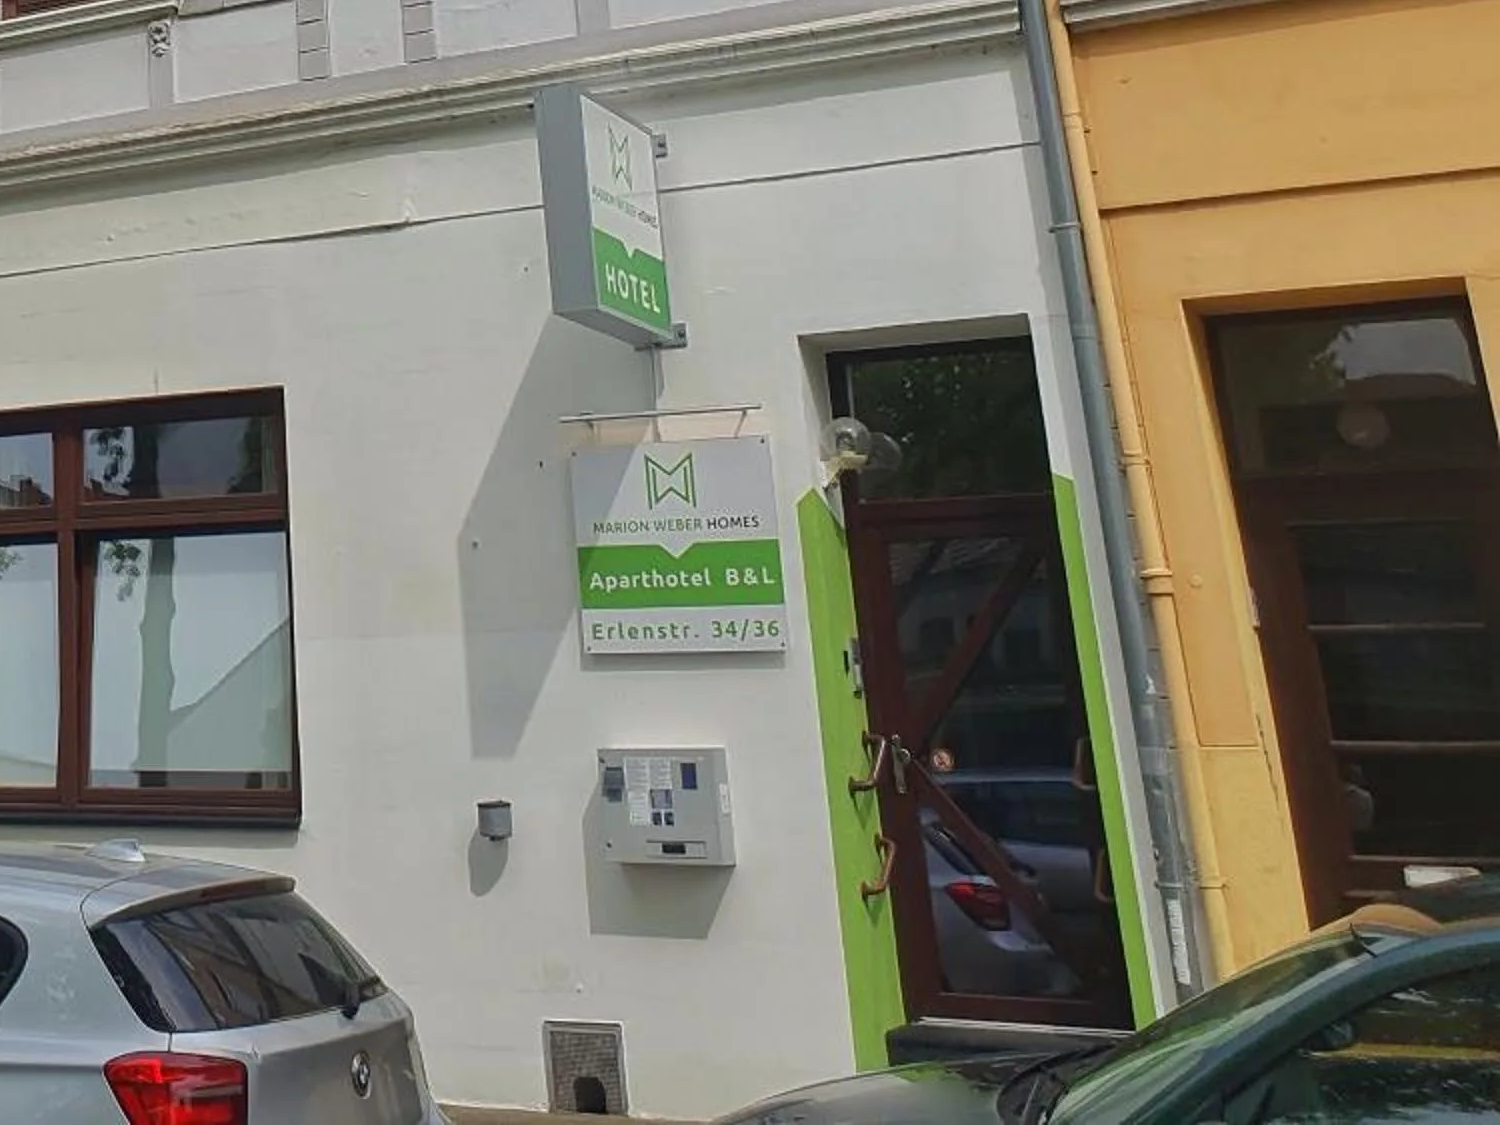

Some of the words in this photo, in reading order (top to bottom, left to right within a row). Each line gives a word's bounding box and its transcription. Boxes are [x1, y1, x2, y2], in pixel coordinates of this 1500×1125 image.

[604, 263, 661, 314] HOTEL
[593, 521, 650, 535] MARION
[653, 518, 703, 532] WEBER
[706, 515, 760, 530] HOMES
[589, 569, 711, 593] Aparthotel
[725, 567, 775, 586] B&L
[592, 623, 700, 641] Erlenstr.
[711, 619, 780, 641] 34/36
